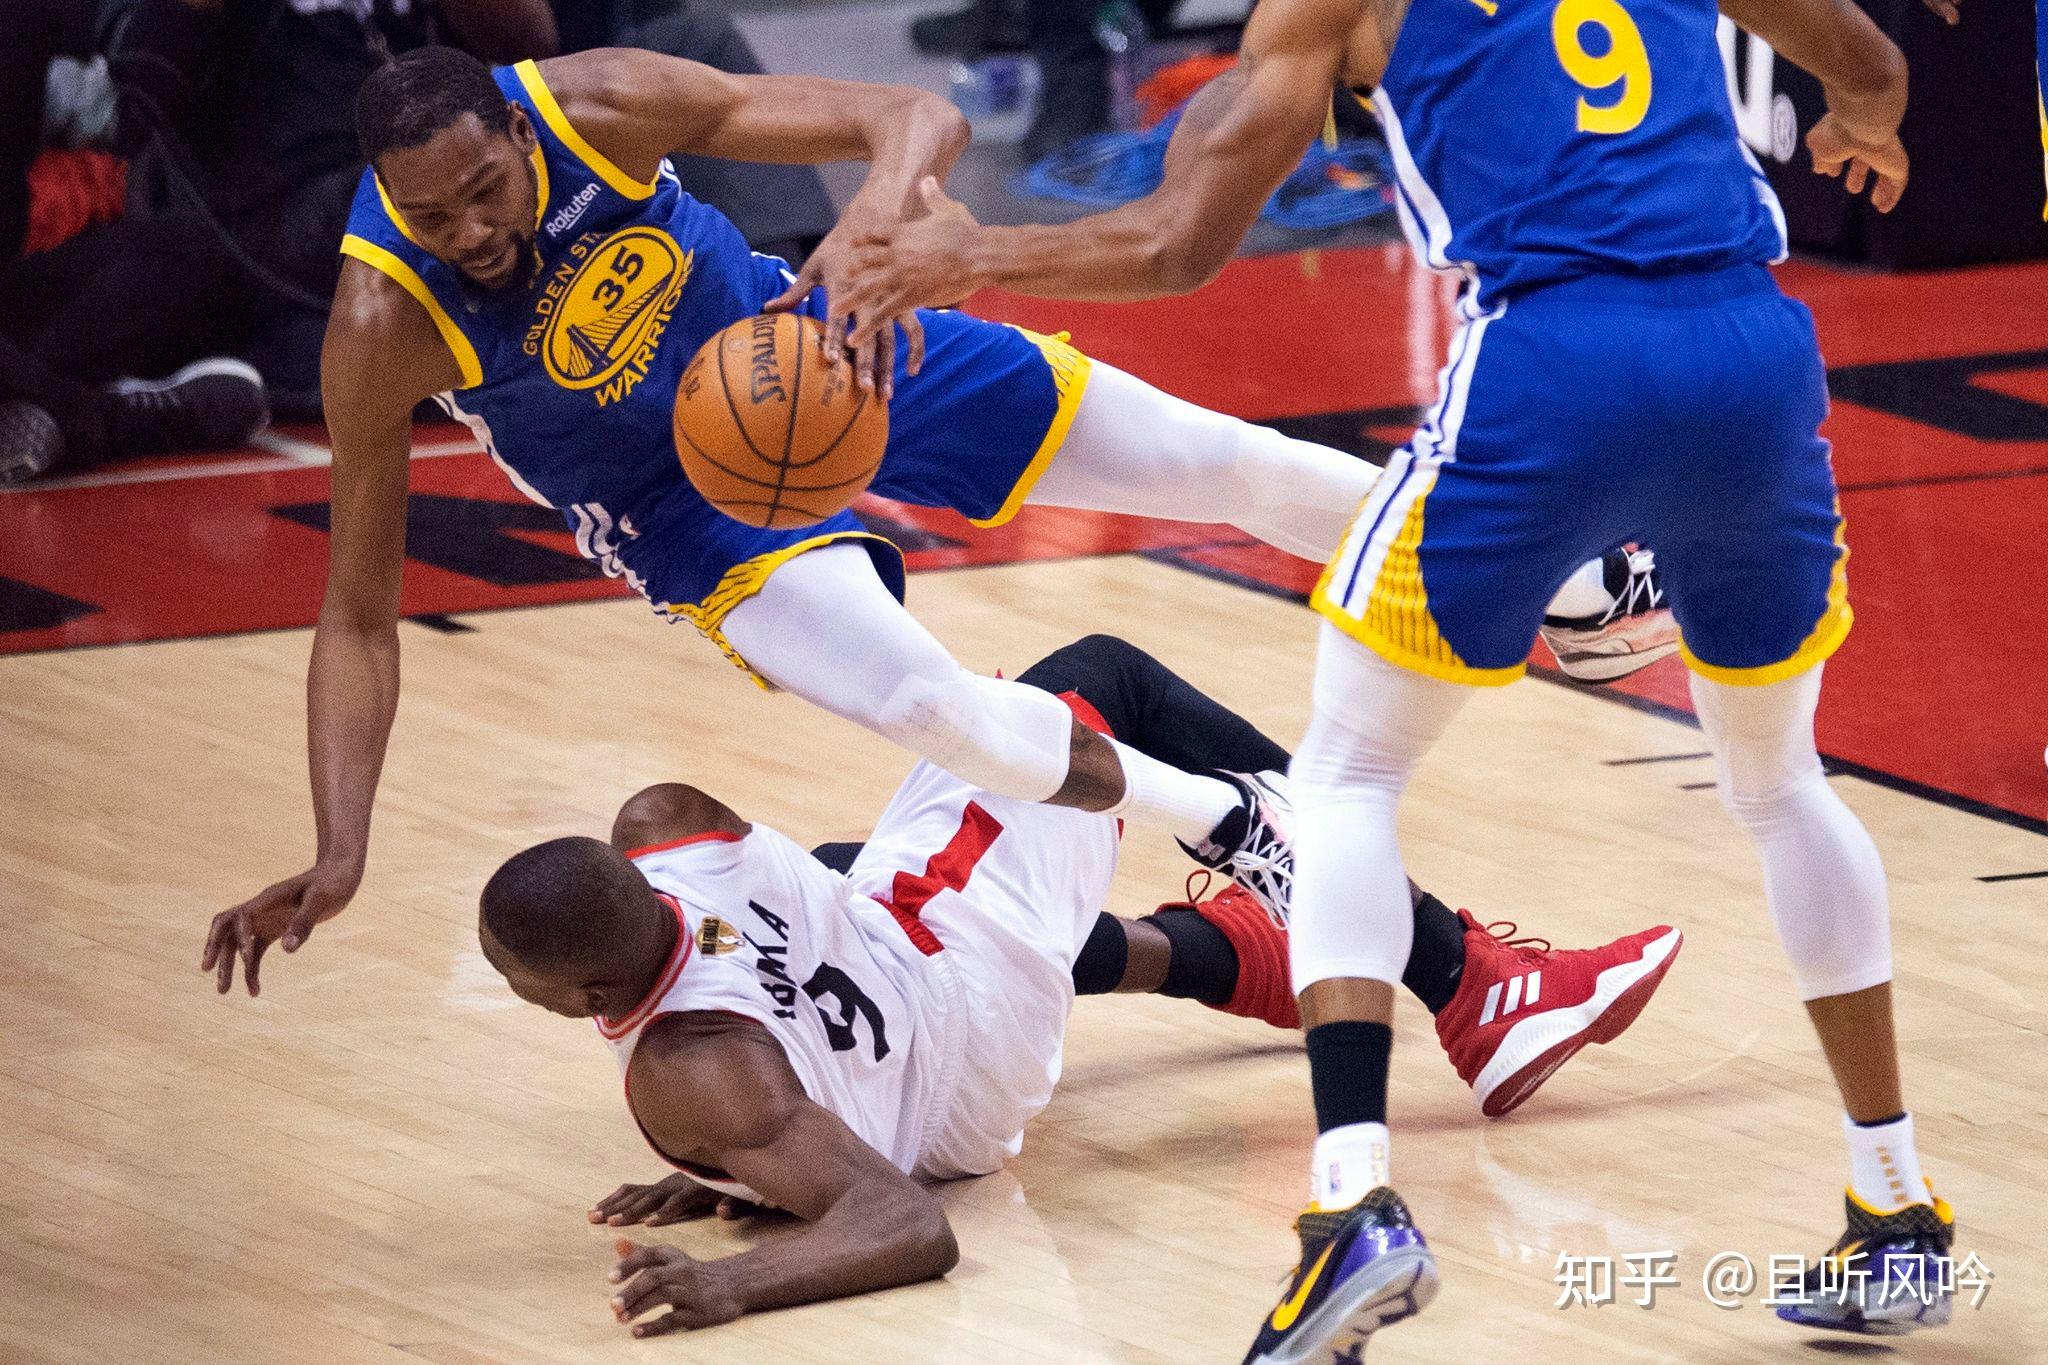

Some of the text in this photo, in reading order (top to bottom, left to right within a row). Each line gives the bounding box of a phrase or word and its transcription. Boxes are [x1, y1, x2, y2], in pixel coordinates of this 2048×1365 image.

[1553, 0, 1652, 134] 9
[545, 183, 602, 238] Rakuten
[523, 262, 577, 356] GOLDEN
[592, 245, 644, 312] 35
[801, 961, 891, 1063] 9
